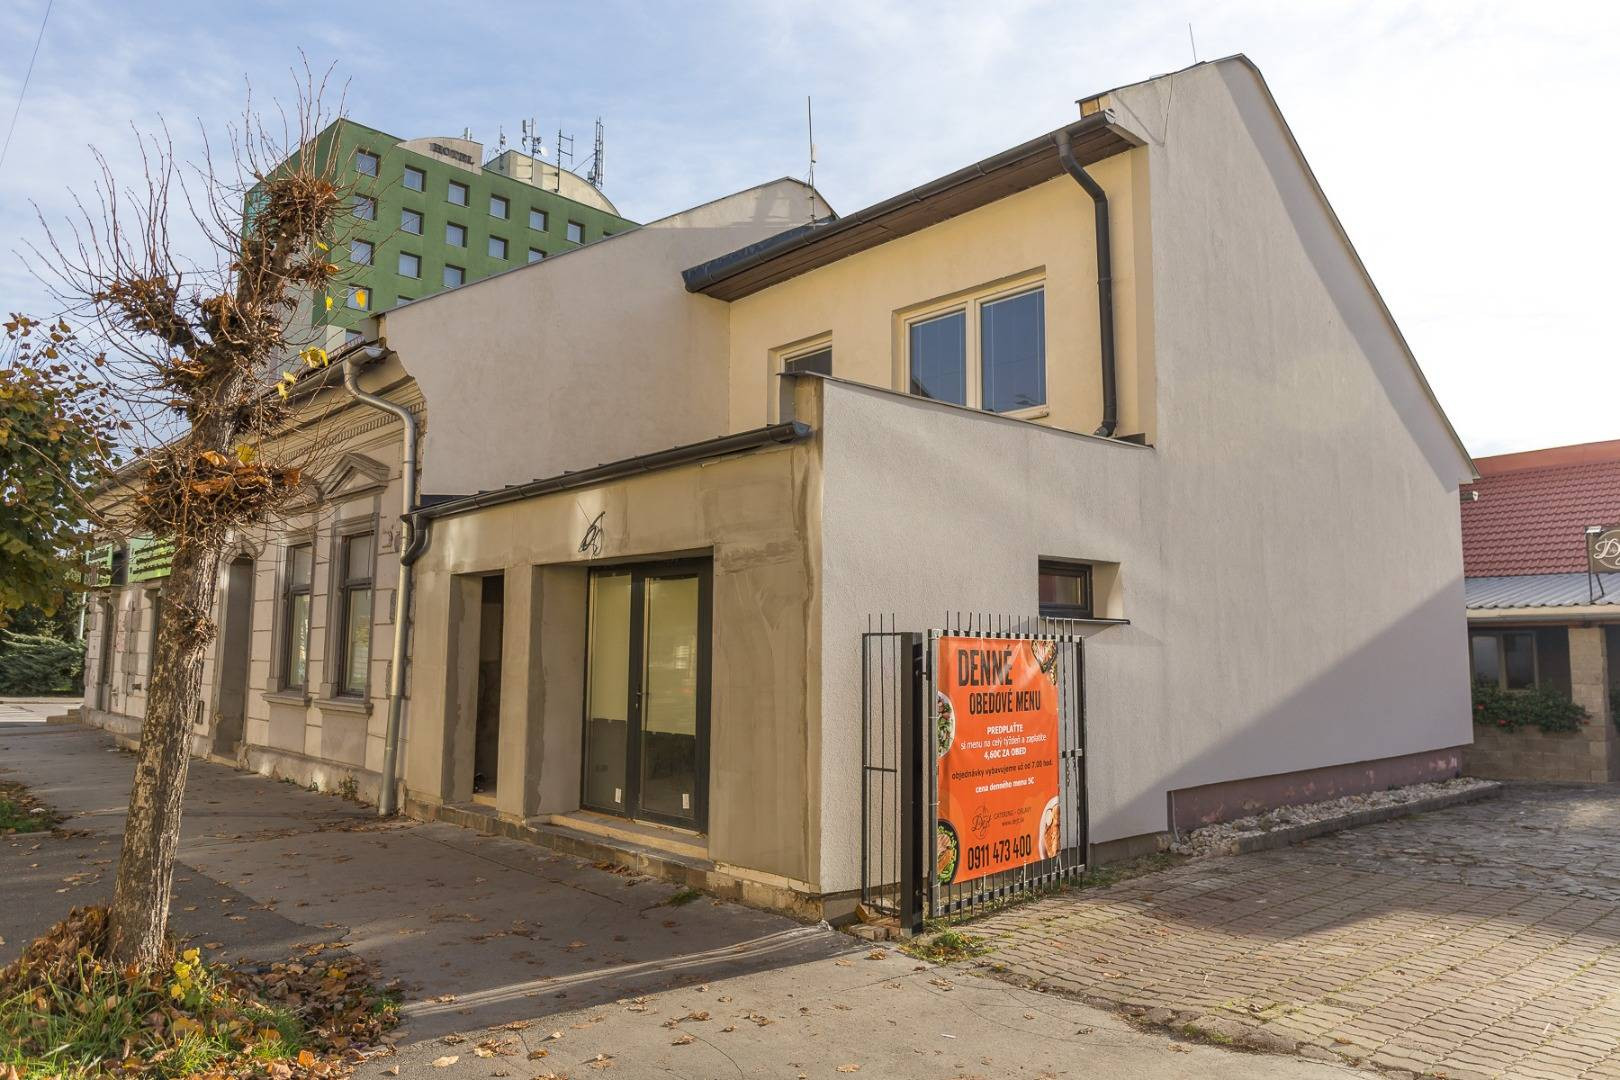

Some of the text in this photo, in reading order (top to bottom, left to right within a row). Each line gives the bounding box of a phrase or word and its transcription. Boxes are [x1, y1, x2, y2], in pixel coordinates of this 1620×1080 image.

[429, 143, 475, 165] HOTEL
[958, 644, 1013, 687] DENNÉ
[969, 689, 1041, 715] OBEDOVÉ MENU
[986, 722, 1024, 735] PREDPLAŤTE
[966, 741, 983, 750] menu
[992, 737, 1002, 748] celý
[1002, 748, 1010, 757] ZA
[1011, 747, 1026, 756] OBED
[975, 785, 988, 794] cena
[1012, 779, 1027, 787] menu
[968, 834, 1031, 870] 0911 473 400
